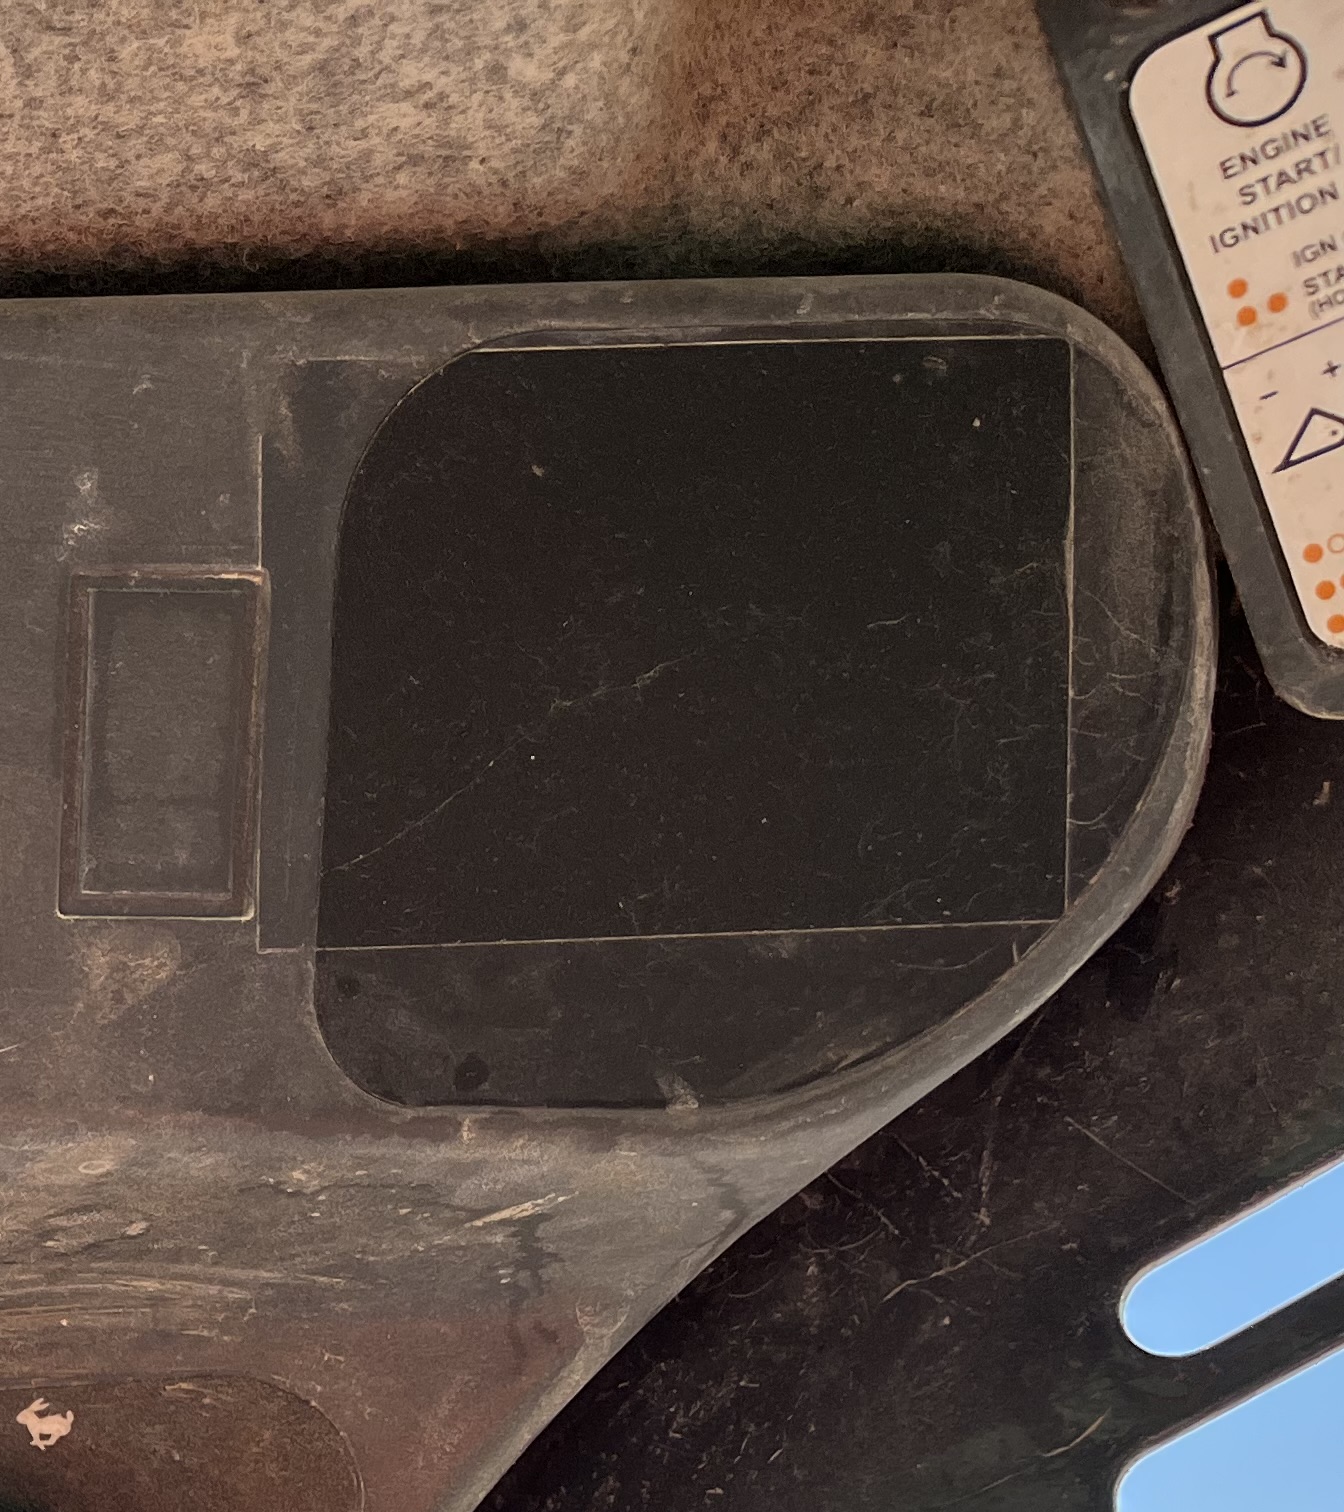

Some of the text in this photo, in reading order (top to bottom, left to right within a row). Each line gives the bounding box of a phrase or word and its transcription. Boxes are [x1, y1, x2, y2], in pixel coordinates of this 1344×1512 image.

[1219, 112, 1332, 180] ENGINE
[1209, 180, 1340, 254] IGNITION
[1292, 233, 1338, 267] IGN
